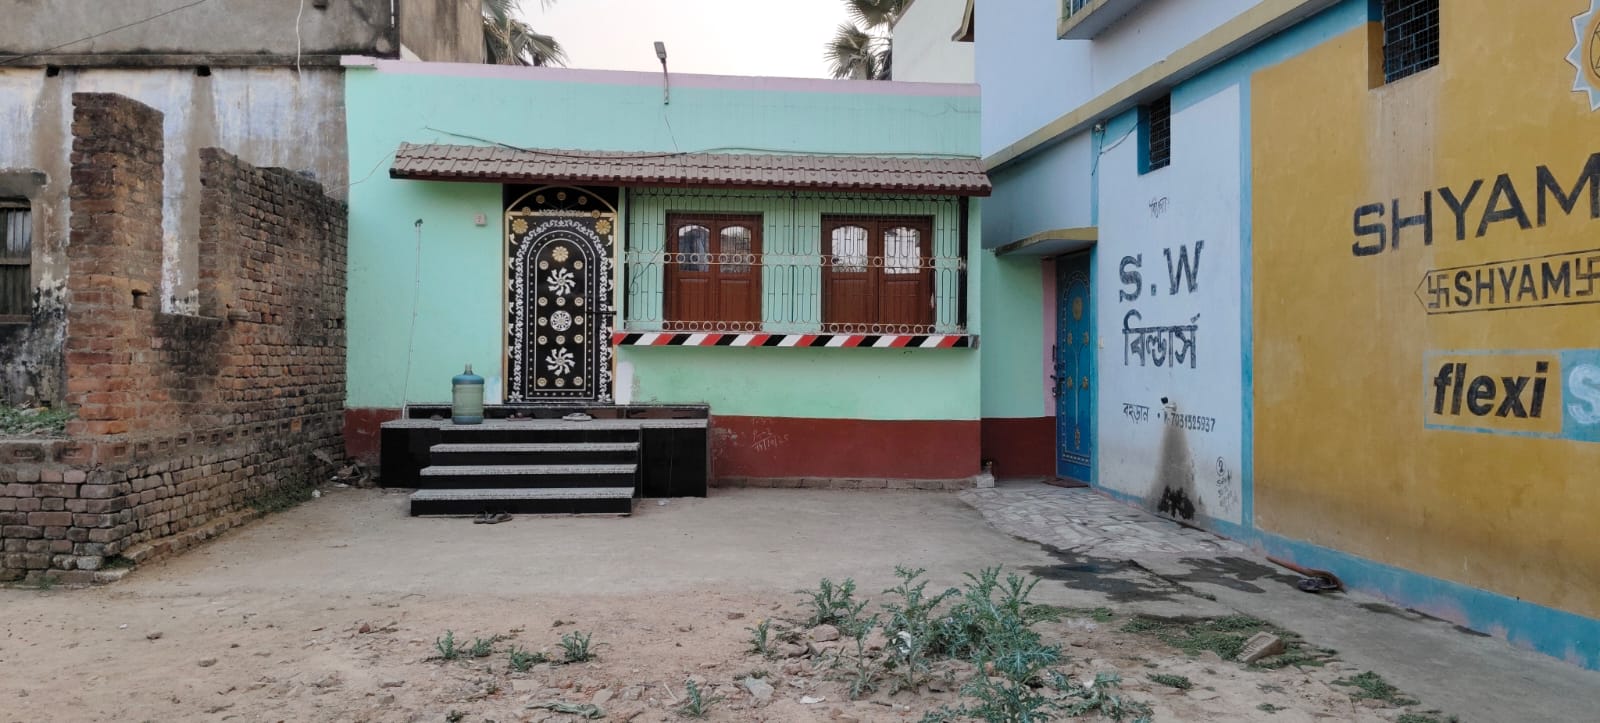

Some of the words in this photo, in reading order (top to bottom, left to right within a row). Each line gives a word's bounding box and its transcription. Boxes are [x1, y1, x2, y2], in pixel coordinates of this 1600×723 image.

[1352, 152, 1600, 257] SHYAM
[1454, 260, 1571, 307] SHYAM
[1433, 360, 1549, 418] flexi
